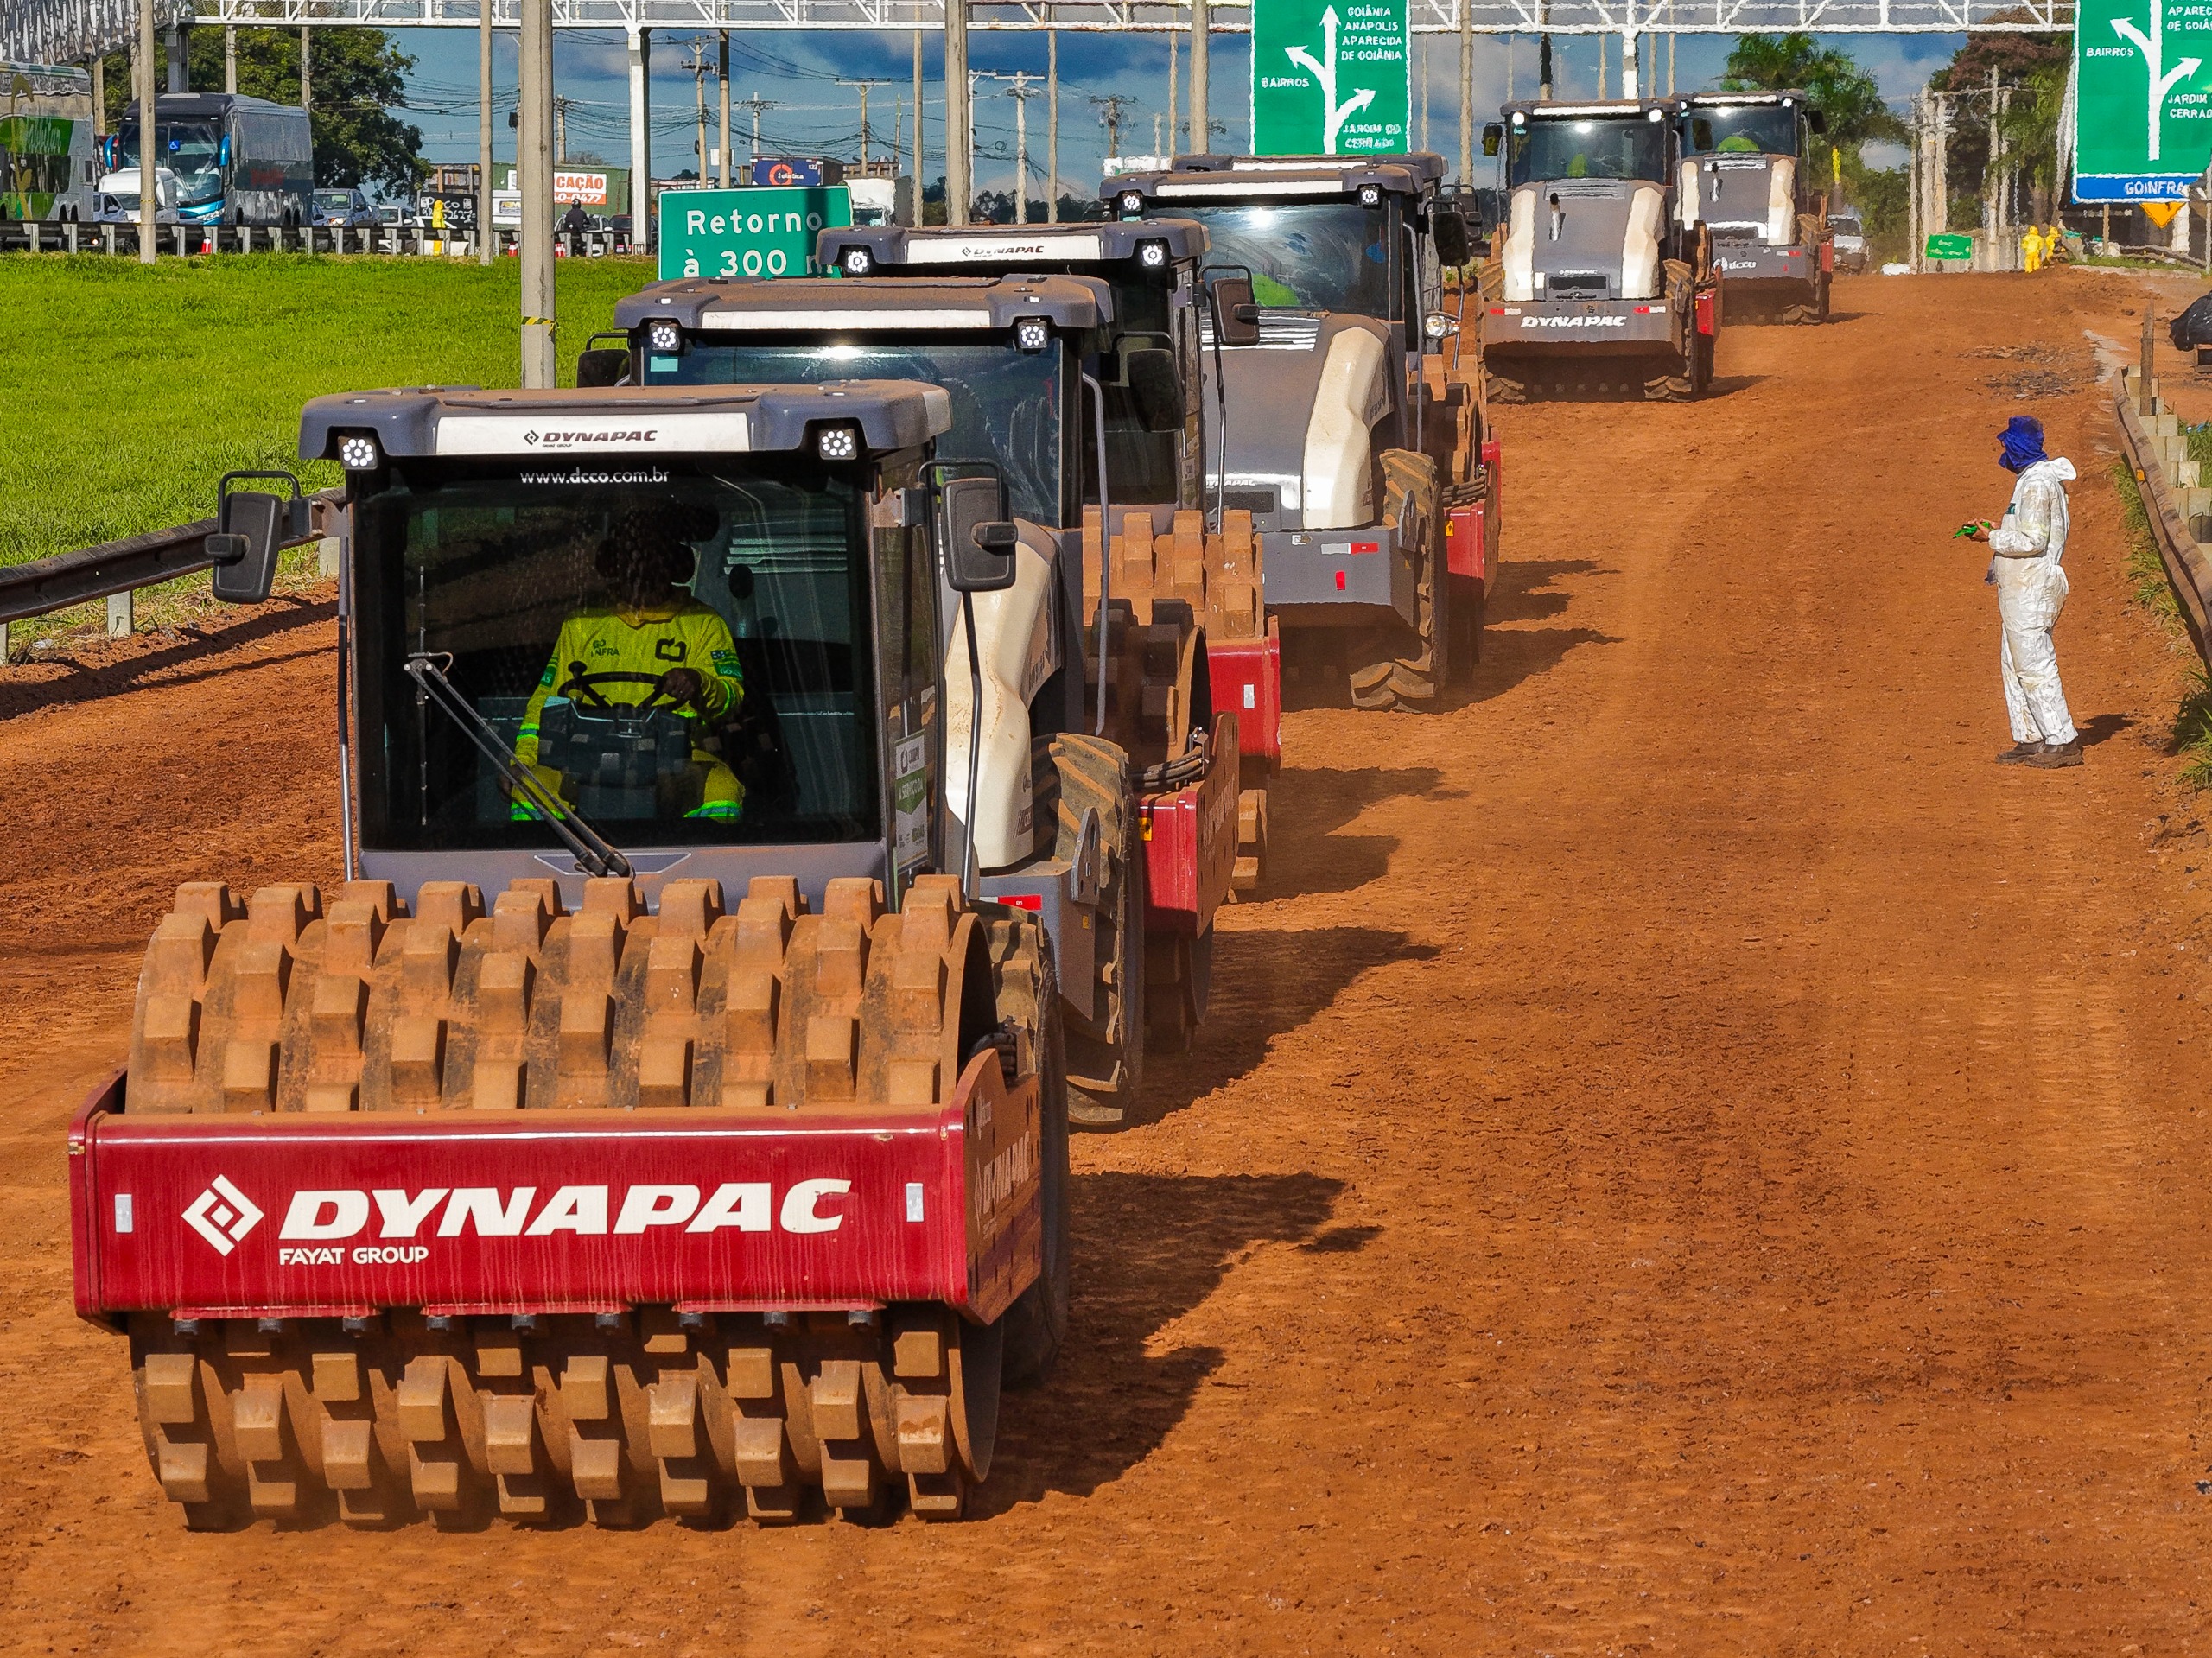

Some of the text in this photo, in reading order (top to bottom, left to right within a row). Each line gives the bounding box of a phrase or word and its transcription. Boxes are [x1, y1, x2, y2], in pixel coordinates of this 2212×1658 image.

[1348, 5, 1391, 17] GOIÂNIA
[1344, 19, 1398, 31] ANÁPOLIS
[2167, 18, 2212, 31] DE GOIÂ
[1342, 36, 1402, 46] APARECIDA
[1341, 48, 1402, 60] DE GOIÂNIA
[2086, 47, 2134, 57] BAIRROS
[1262, 77, 1310, 88] BAIRROS
[2168, 94, 2208, 105] JARDIM
[555, 175, 604, 192] CAÇÃO
[687, 209, 822, 235] Retorno
[683, 249, 700, 277] à
[720, 249, 787, 276] 300
[1521, 316, 1627, 328] DYNAPAC
[543, 430, 658, 442] DYNAPAC
[520, 466, 670, 484] www.dcco.com.br
[278, 1179, 852, 1237] DYNAPAC
[279, 1246, 429, 1266] FAYAT GROUP
